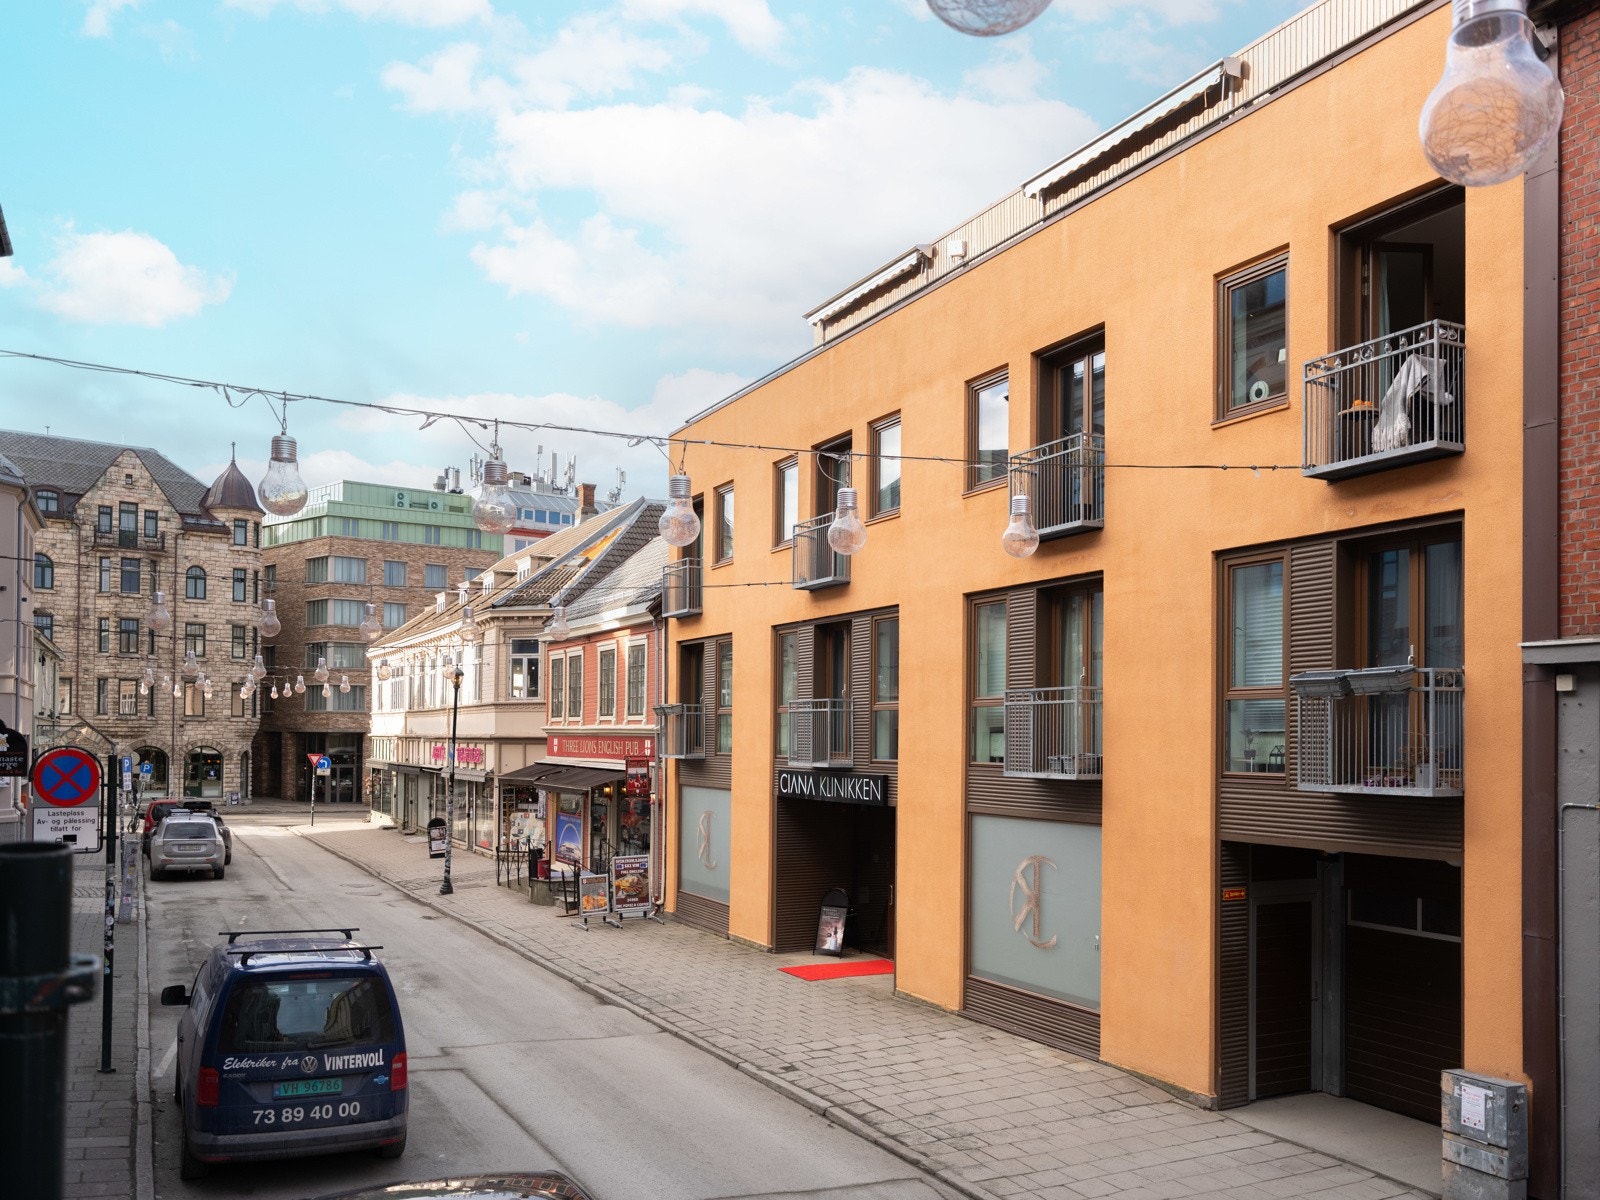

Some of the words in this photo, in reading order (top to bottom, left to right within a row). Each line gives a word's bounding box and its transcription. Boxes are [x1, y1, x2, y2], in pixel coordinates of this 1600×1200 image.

[562, 739, 579, 752] THREE
[580, 740, 597, 754] LIONS
[598, 740, 623, 755] ENGLISH
[625, 741, 639, 756] PUB
[143, 764, 150, 772] P
[780, 773, 815, 795] CIANA
[820, 776, 880, 801] KLINIKKEN
[223, 1057, 277, 1070] Elektriker
[281, 1056, 299, 1070] fra
[324, 1048, 384, 1071] VINTERVOLL
[282, 1083, 299, 1094] VH
[304, 1079, 340, 1092] 96786
[252, 1109, 275, 1125] 73
[281, 1107, 304, 1122] 89
[310, 1105, 332, 1119] 40
[338, 1101, 361, 1117] 00
